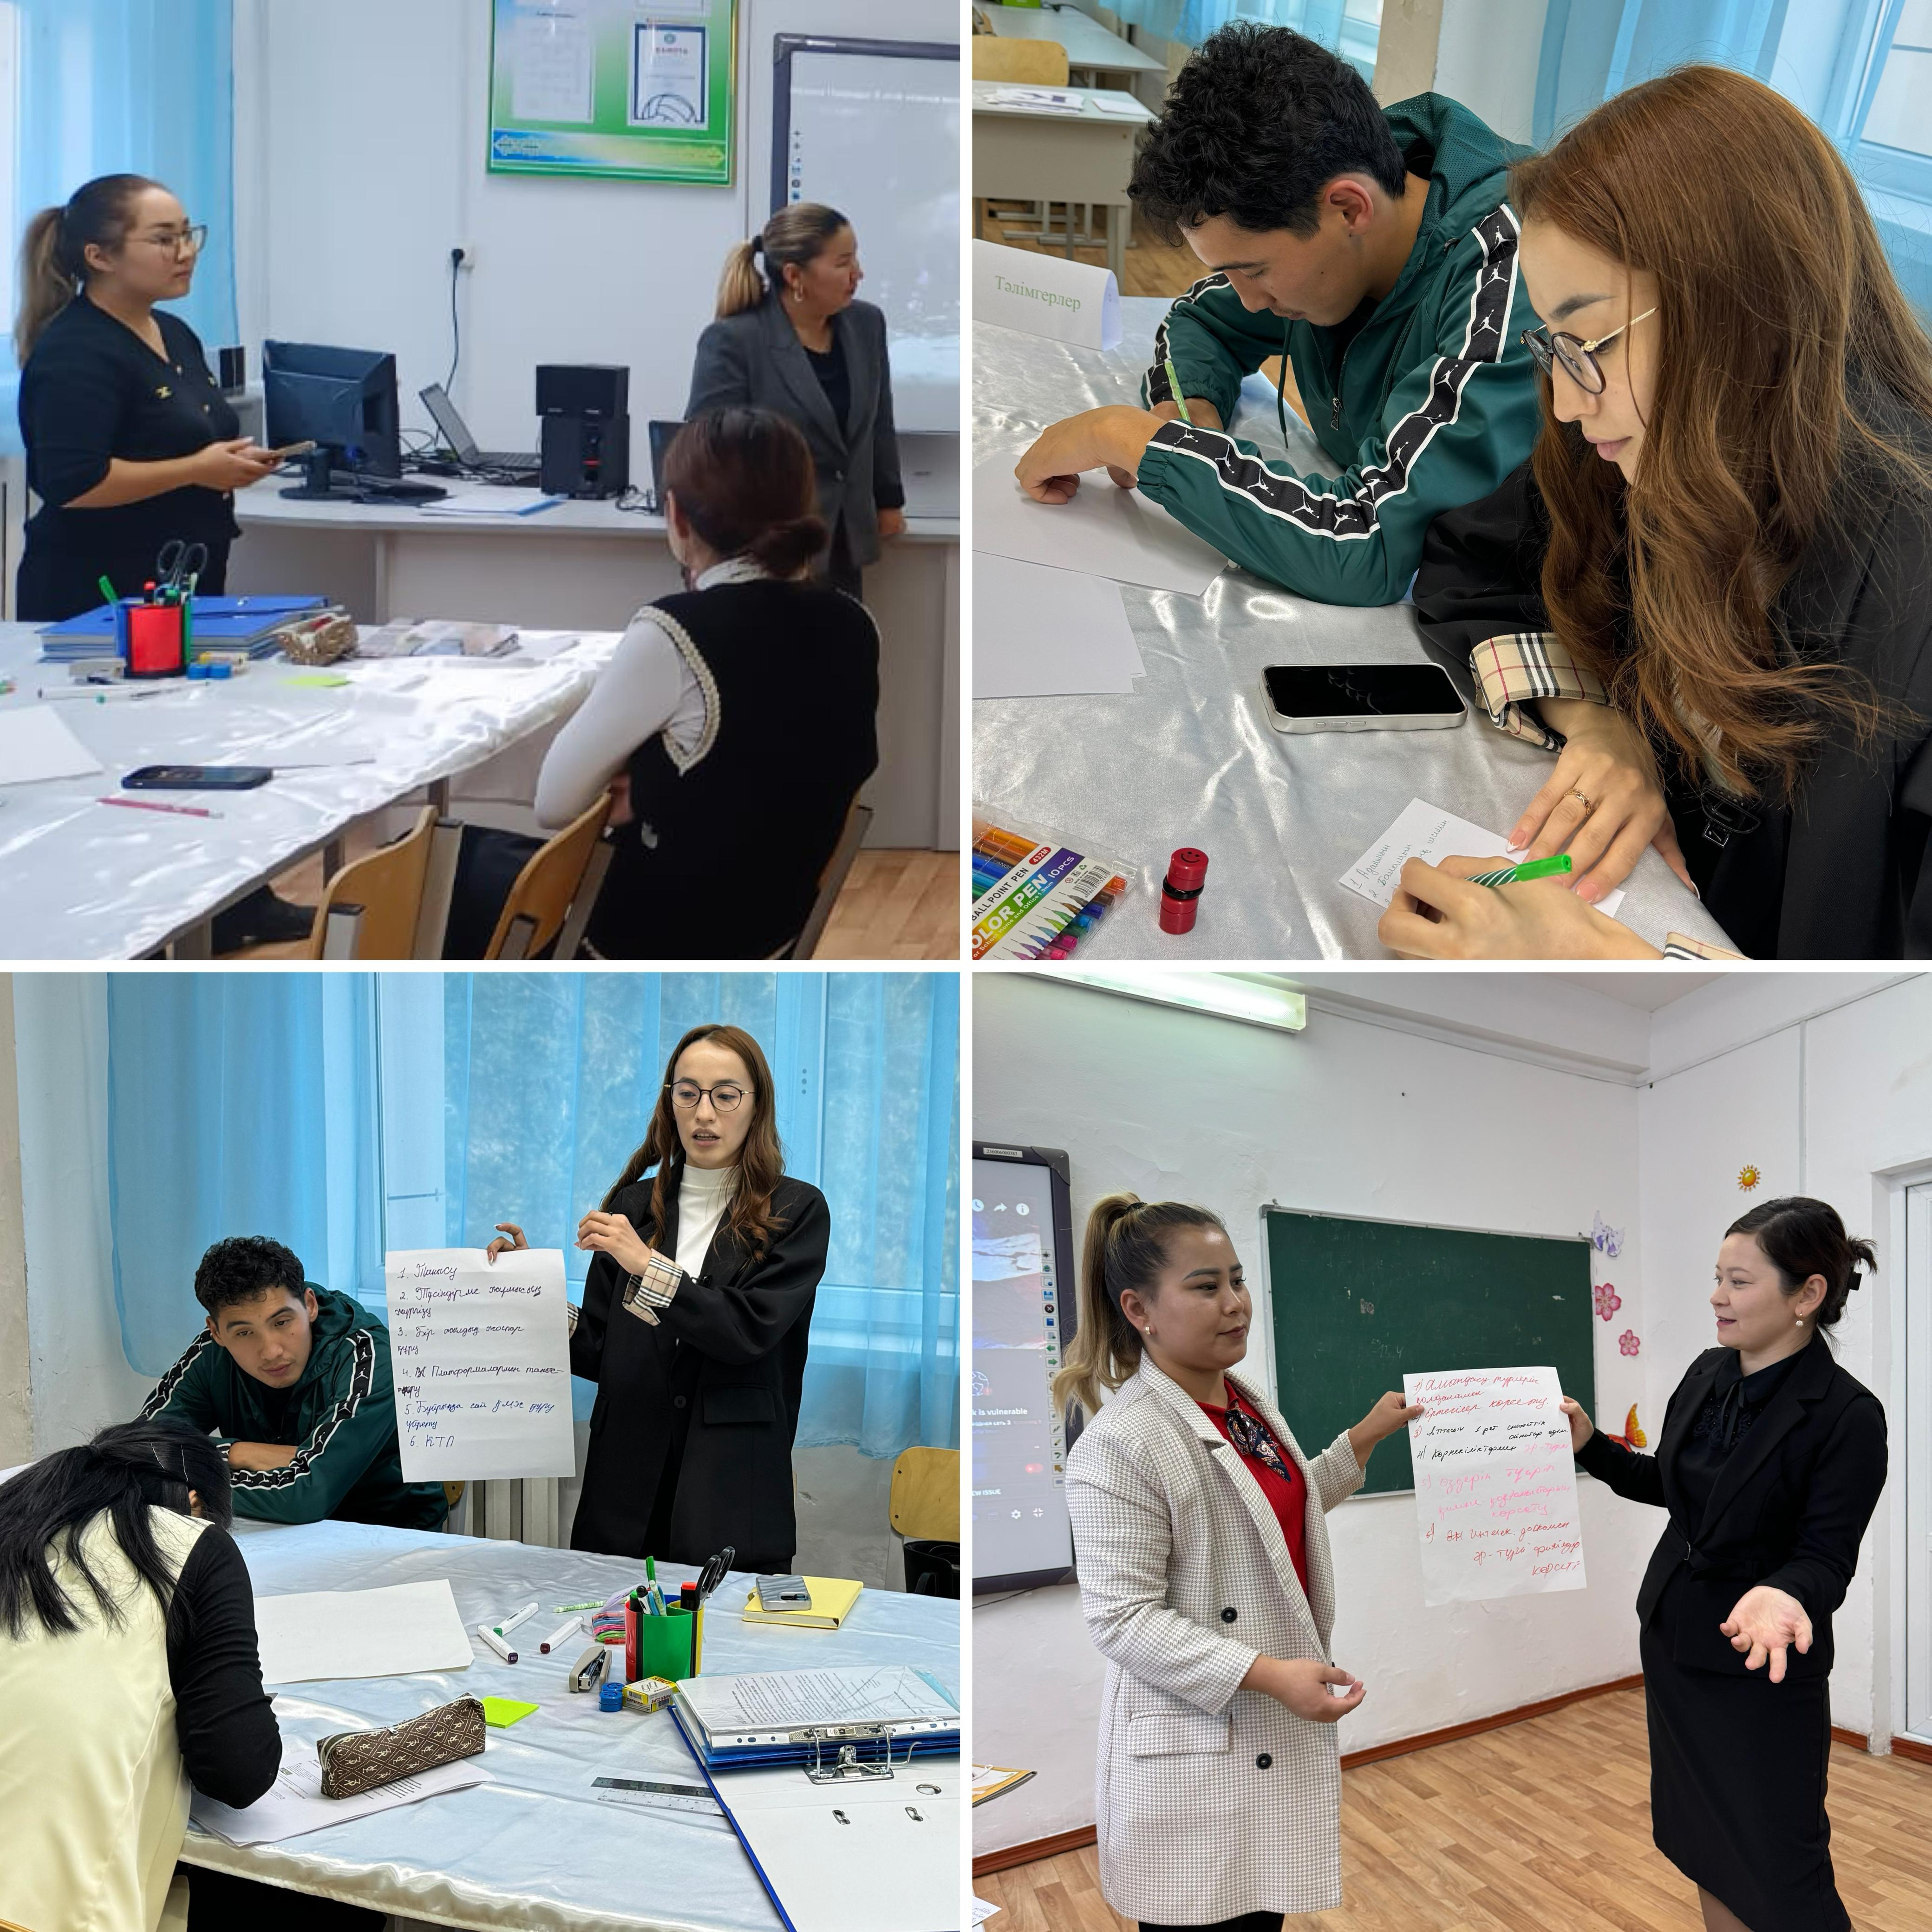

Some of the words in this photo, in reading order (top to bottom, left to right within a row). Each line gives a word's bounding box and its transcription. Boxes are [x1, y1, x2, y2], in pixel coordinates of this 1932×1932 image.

[995, 275, 1081, 312] Тәлімгерлер
[1032, 849, 1050, 863] 432M
[987, 882, 1012, 903] POINT
[1011, 868, 1029, 882] PEN
[1013, 873, 1048, 907] PEN
[979, 934, 999, 951] School
[999, 919, 1014, 933] Home
[1014, 909, 1024, 919] and
[1024, 894, 1039, 909] Office
[1038, 881, 1054, 895] 1.0mm
[398, 1267, 408, 1279] 1.
[414, 1263, 457, 1280] Танысу
[399, 1292, 408, 1300] 2.
[398, 1327, 407, 1336] 3.
[402, 1368, 411, 1377] 4.
